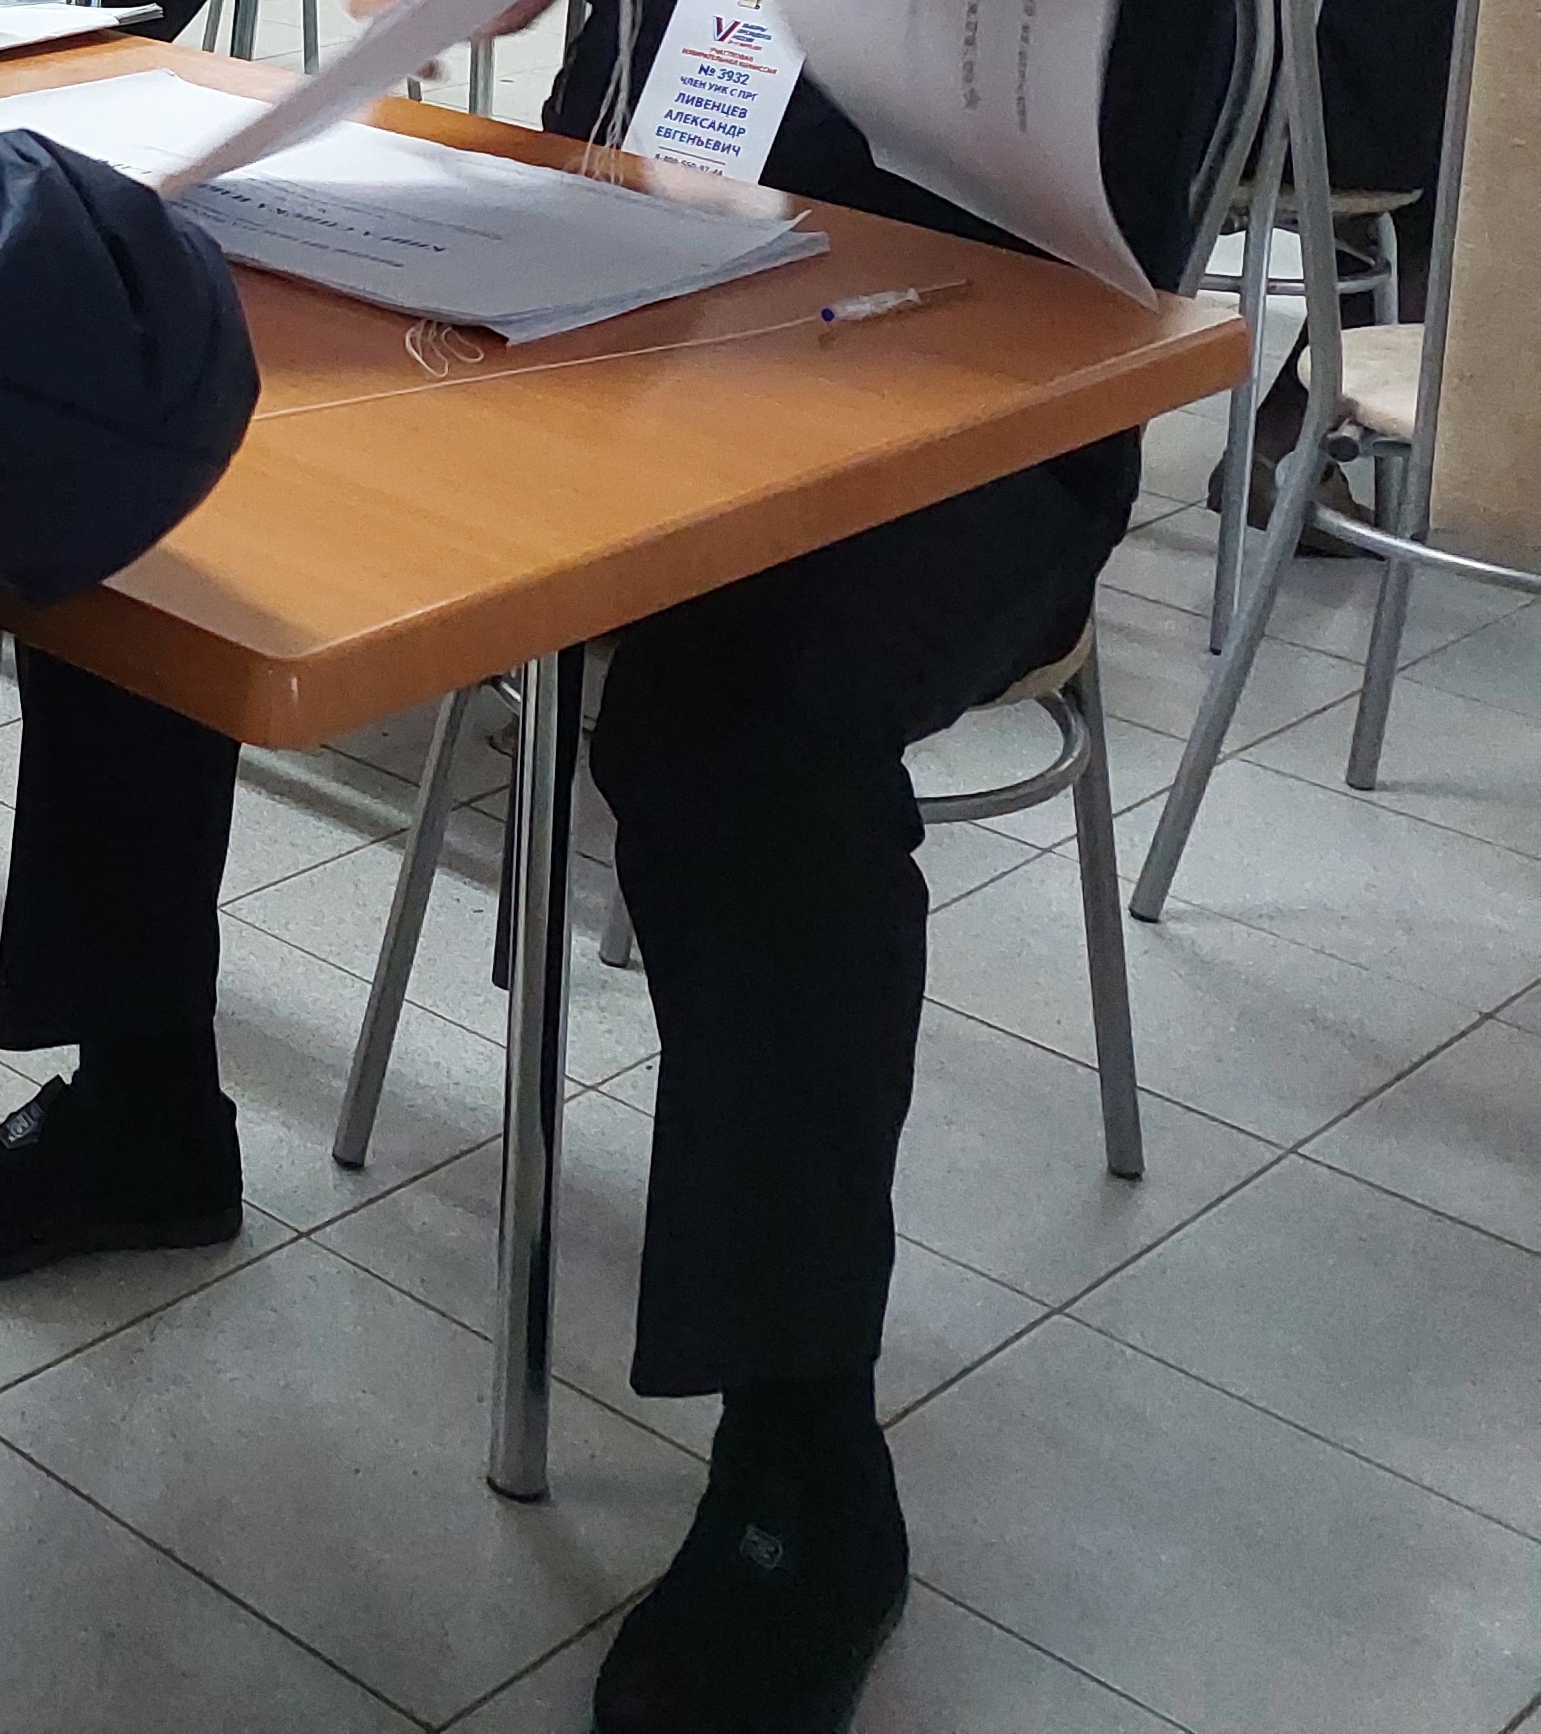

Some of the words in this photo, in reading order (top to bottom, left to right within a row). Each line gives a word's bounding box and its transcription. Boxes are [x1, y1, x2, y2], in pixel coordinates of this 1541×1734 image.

[717, 68, 750, 86] 3932
[674, 92, 749, 119] ЛИВЕНЦЕВ
[664, 109, 747, 139] АЛЕКСАНДР
[656, 126, 742, 157] ЕВГЕНЬЕВИЧ
